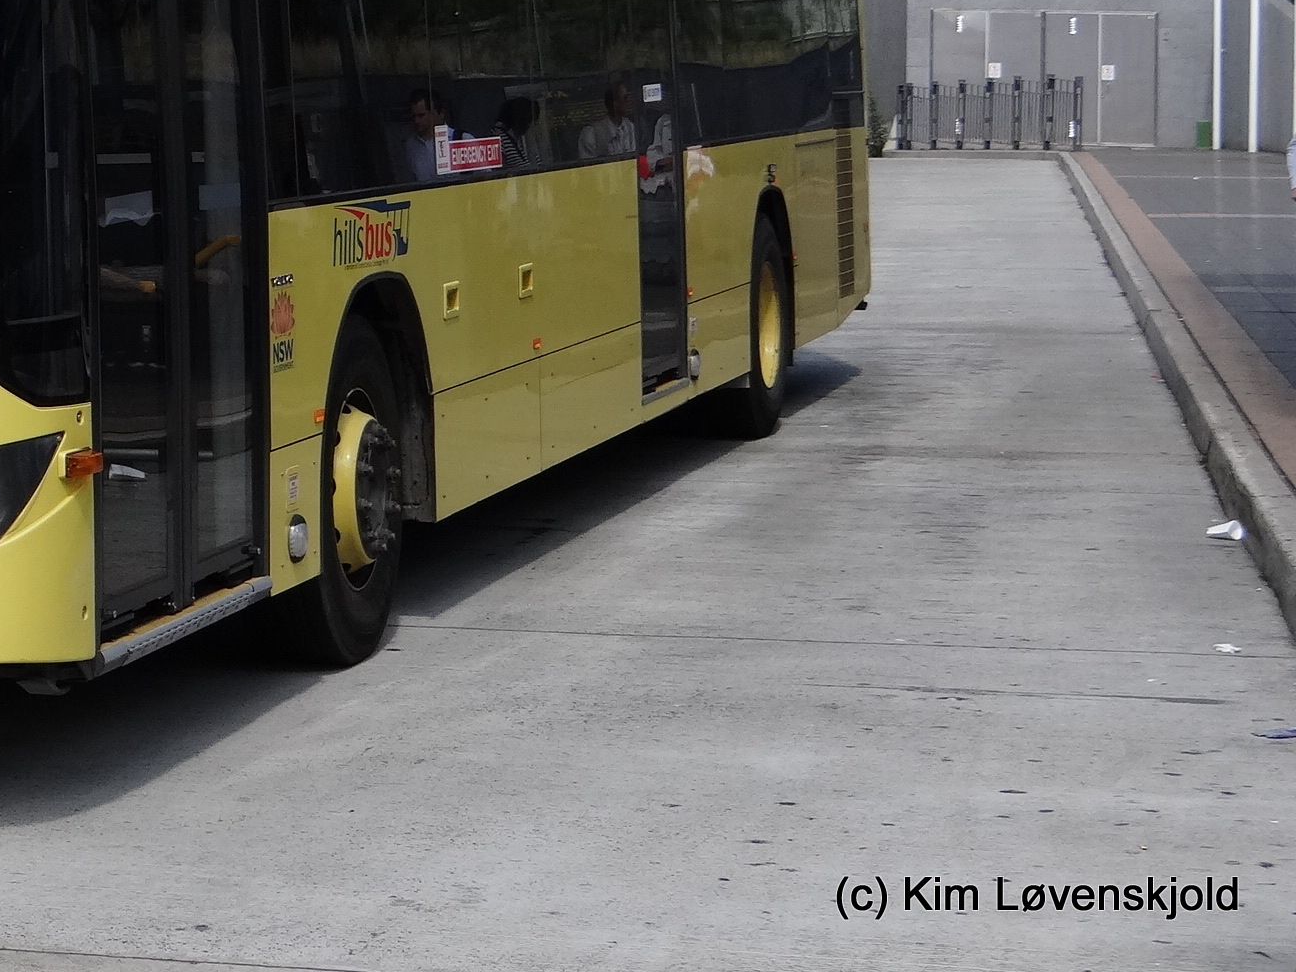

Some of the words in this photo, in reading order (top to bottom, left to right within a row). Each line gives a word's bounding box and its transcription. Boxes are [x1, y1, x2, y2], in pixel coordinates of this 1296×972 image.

[451, 144, 486, 165] EMERGENCY
[487, 143, 499, 160] EXIT
[333, 213, 392, 266] hillsbus
[272, 338, 294, 364] NSW
